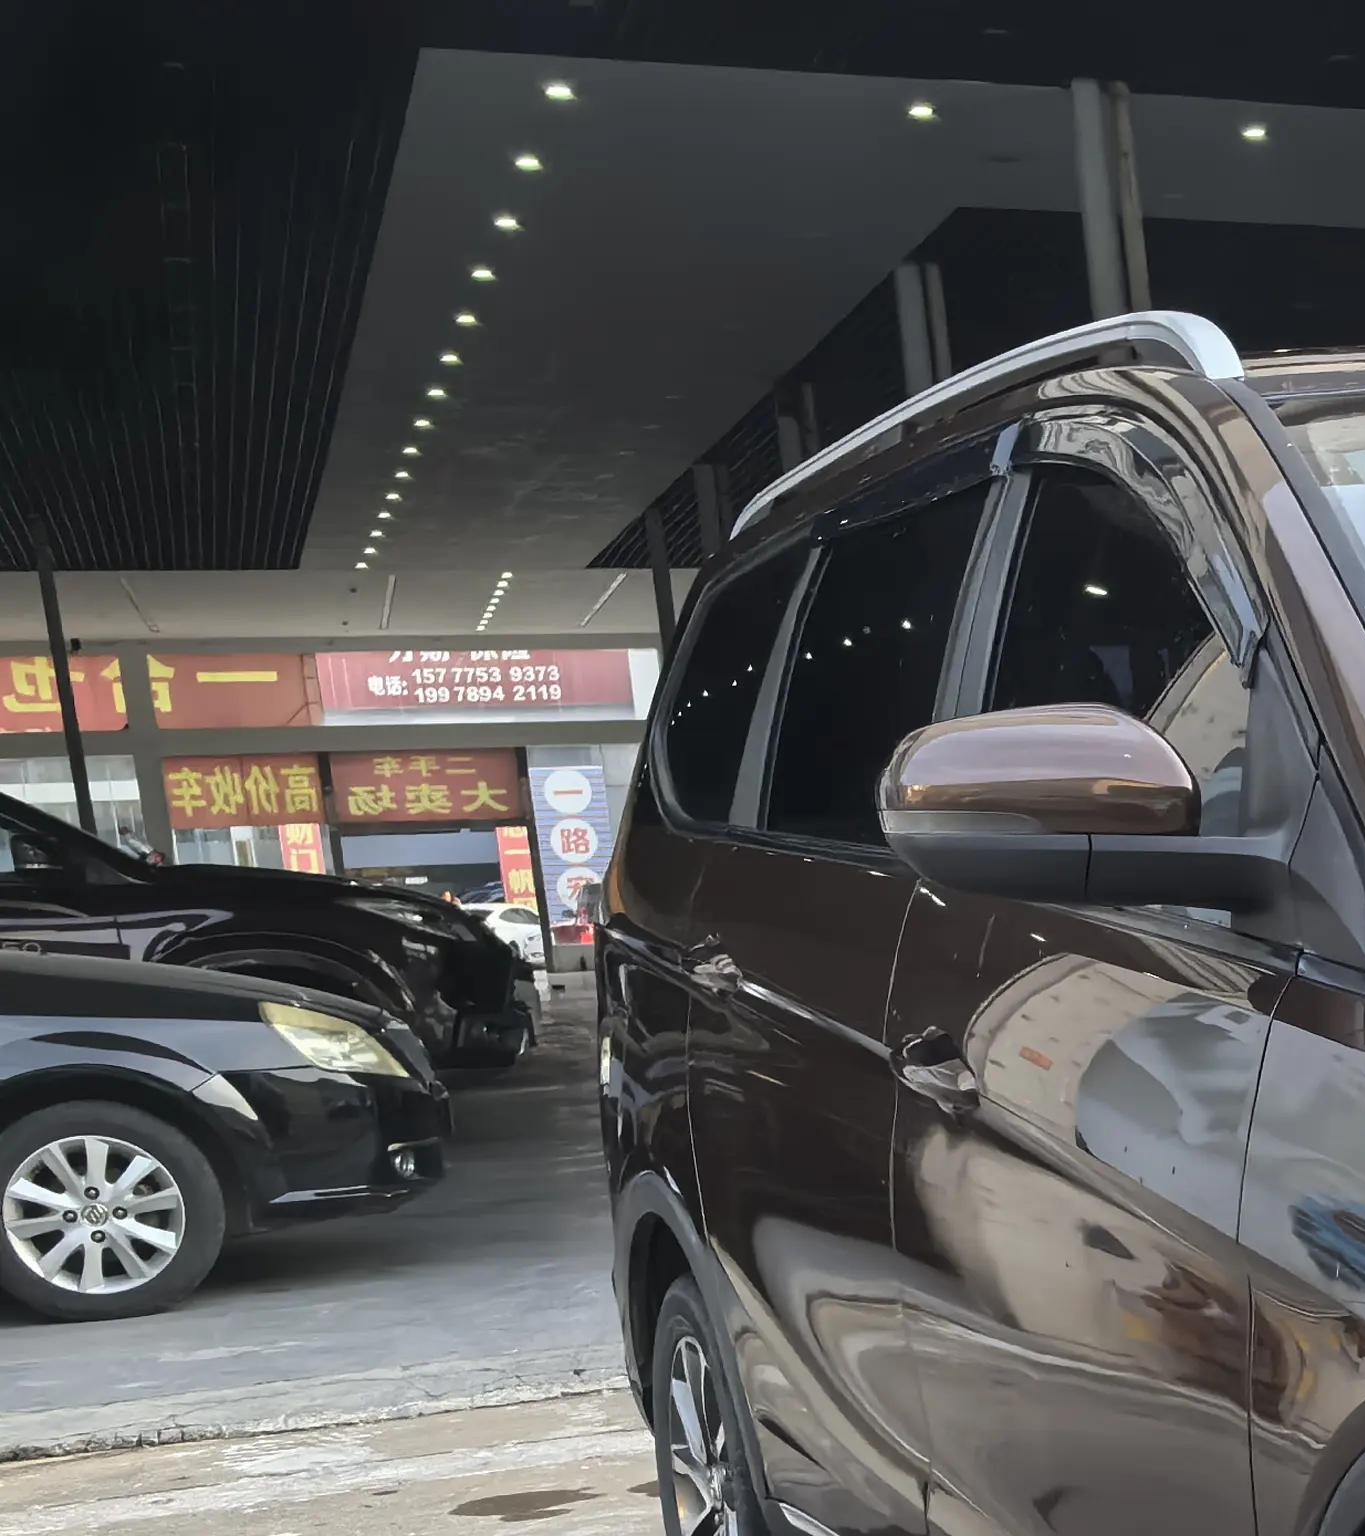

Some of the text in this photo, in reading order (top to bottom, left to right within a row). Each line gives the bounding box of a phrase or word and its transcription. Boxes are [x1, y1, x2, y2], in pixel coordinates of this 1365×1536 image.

[412, 665, 560, 684] 157 7753 9373
[413, 684, 562, 704] 199 7894 2119
